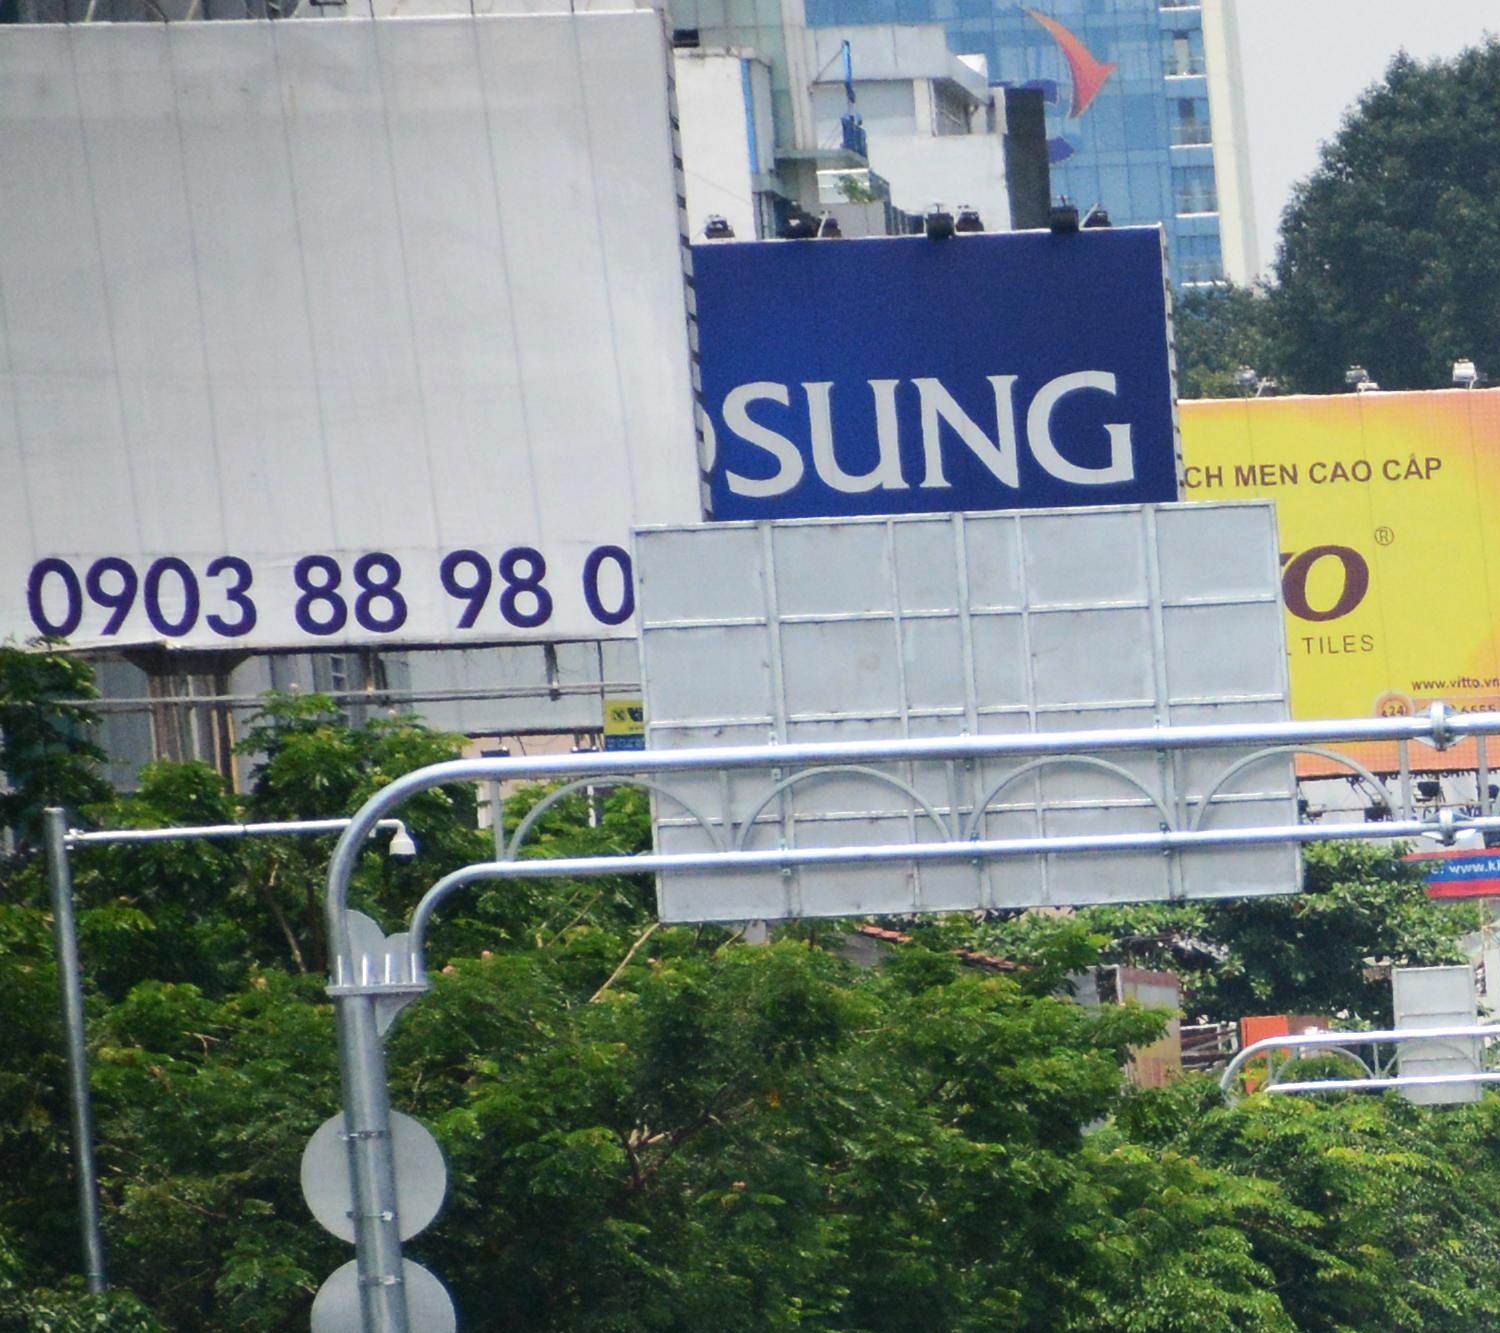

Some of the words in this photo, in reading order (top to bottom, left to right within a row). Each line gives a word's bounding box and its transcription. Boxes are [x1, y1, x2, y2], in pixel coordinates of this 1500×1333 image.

[1234, 463, 1299, 488] MEN
[1308, 459, 1373, 484] CAO
[28, 555, 258, 638] 0903
[293, 551, 409, 636] 88
[439, 546, 554, 630] 98
[1280, 544, 1370, 623] O
[1301, 634, 1375, 655] TILES
[1411, 676, 1500, 691] www.vitto.vn
